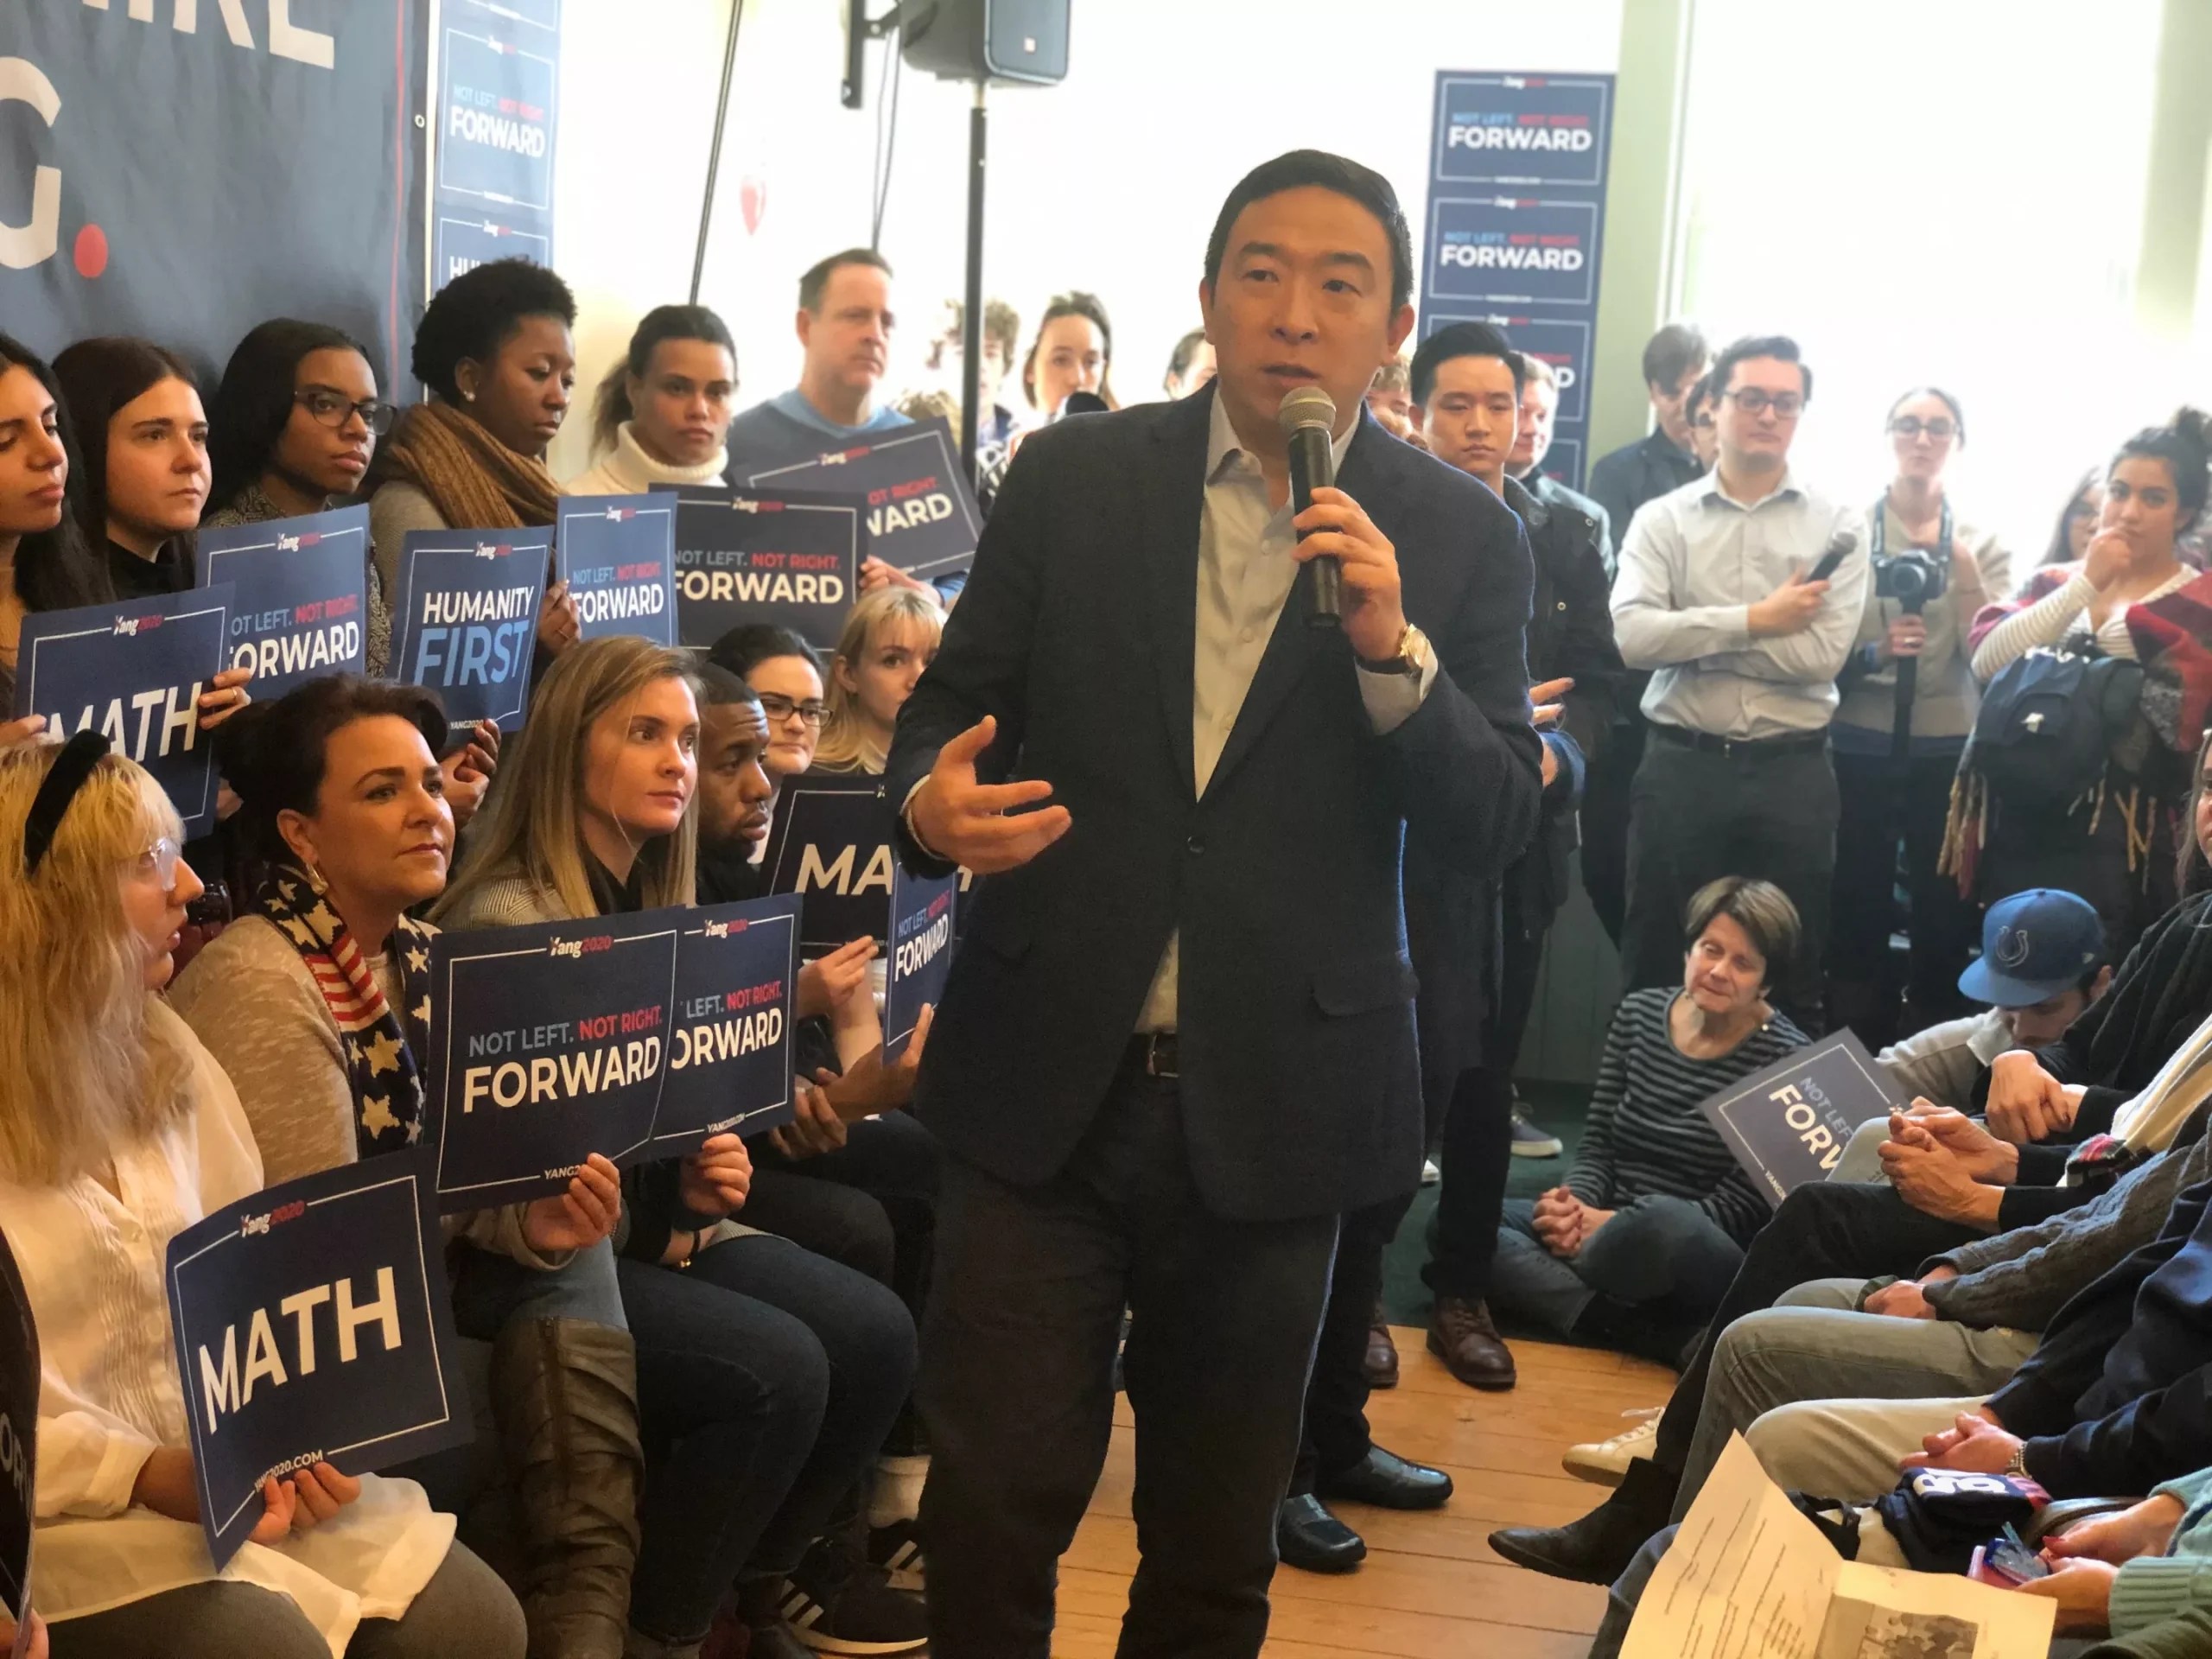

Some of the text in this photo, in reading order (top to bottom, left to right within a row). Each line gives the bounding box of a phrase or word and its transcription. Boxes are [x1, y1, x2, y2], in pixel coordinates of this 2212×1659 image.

[449, 105, 546, 158] FORWARD
[1447, 125, 1592, 152] FORWARD
[1440, 244, 1584, 271] FORWARD
[706, 550, 747, 567] LEFT.
[751, 552, 785, 569] NOT
[789, 553, 841, 570] RIGHT.
[255, 607, 292, 632] LEFT.
[423, 586, 535, 624] HUMANITY
[413, 620, 529, 687] FIRST
[550, 936, 613, 958] Yang2020
[894, 913, 948, 982] FORWARD
[686, 981, 783, 1019] LEFT. NOT RIGHT.
[469, 1005, 663, 1058] NOT LEFT. NOT RIGHT.
[463, 1035, 662, 1114] FORWARD
[198, 1266, 403, 1436] MATH
